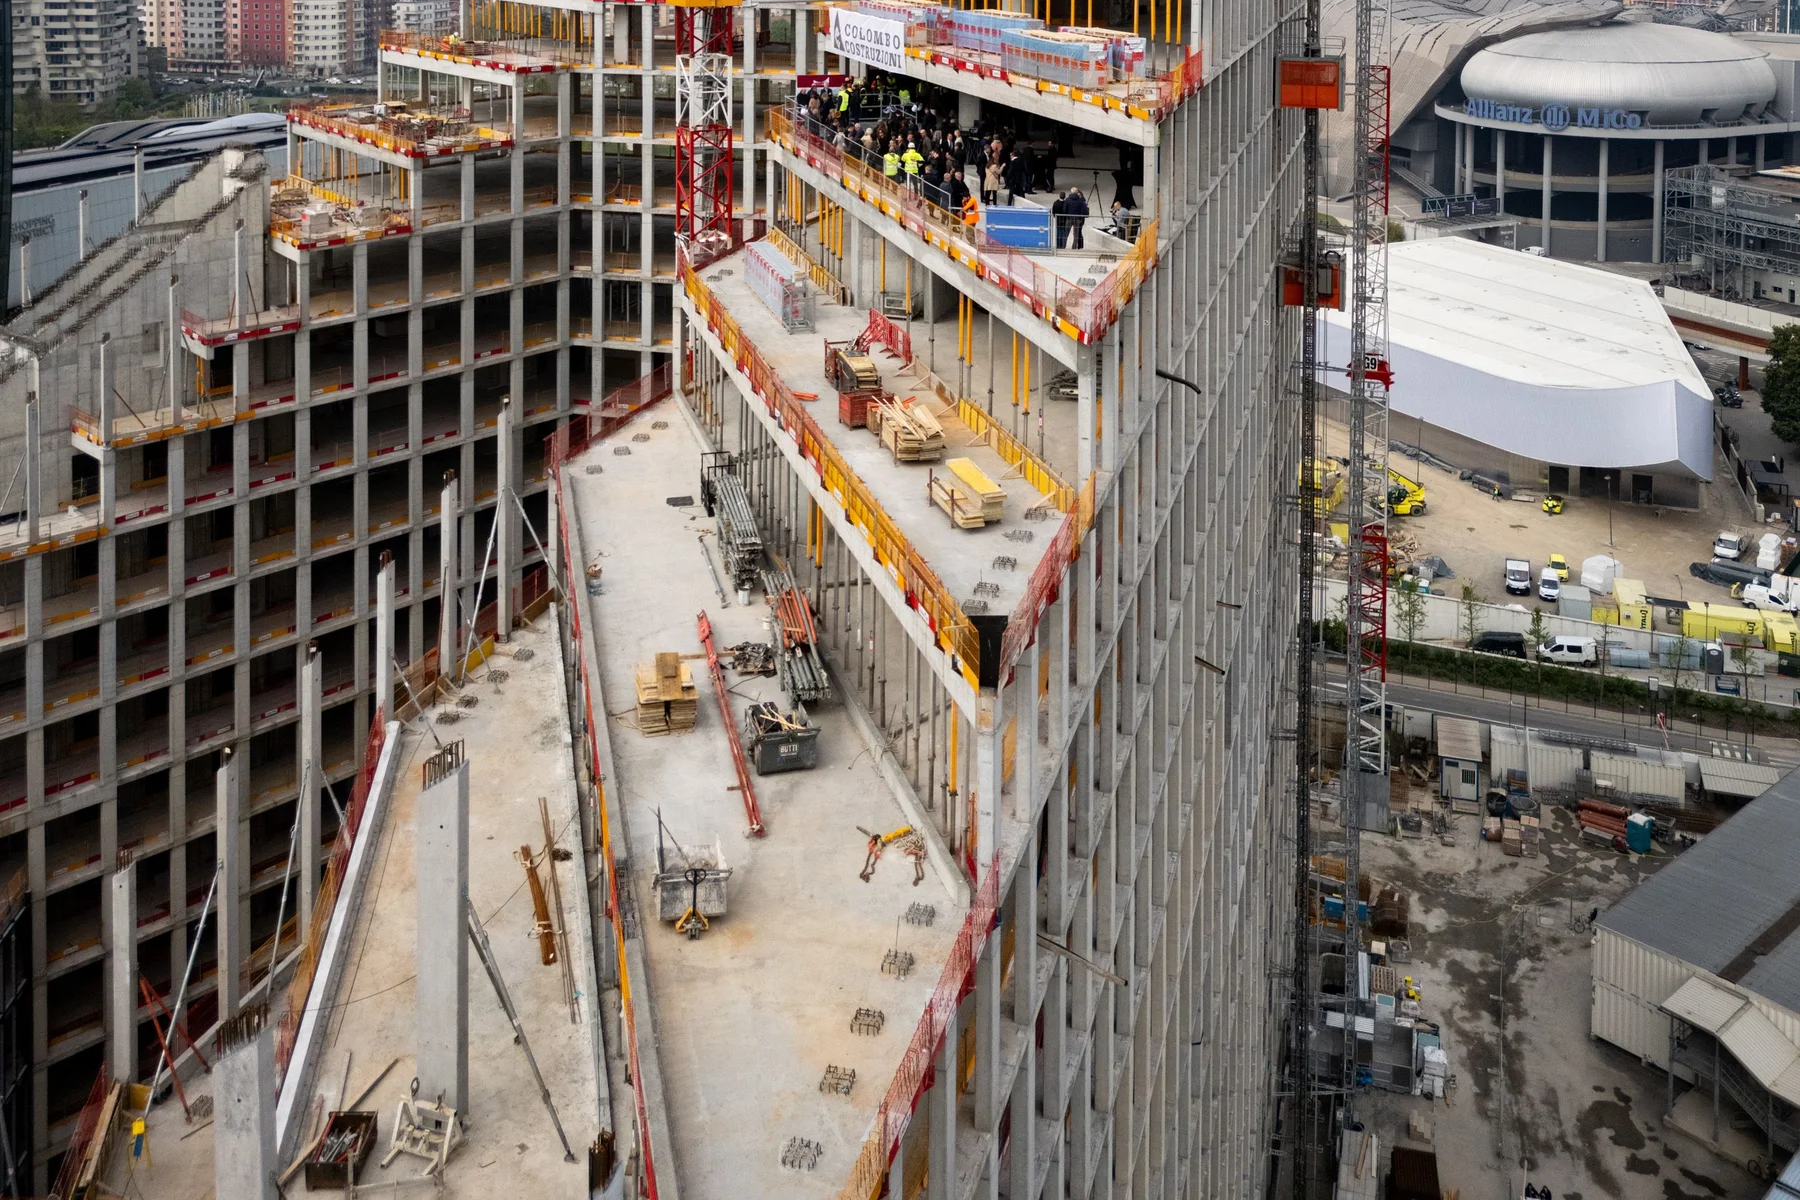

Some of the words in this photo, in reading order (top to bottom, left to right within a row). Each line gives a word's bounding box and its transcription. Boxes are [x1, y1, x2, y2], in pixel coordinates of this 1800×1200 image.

[844, 23, 901, 50] COLOMBO
[844, 40, 902, 69] COSTRUZIONI
[1465, 98, 1533, 124] Allianz
[1577, 107, 1641, 129] MiCo
[780, 744, 798, 754] BUTTI
